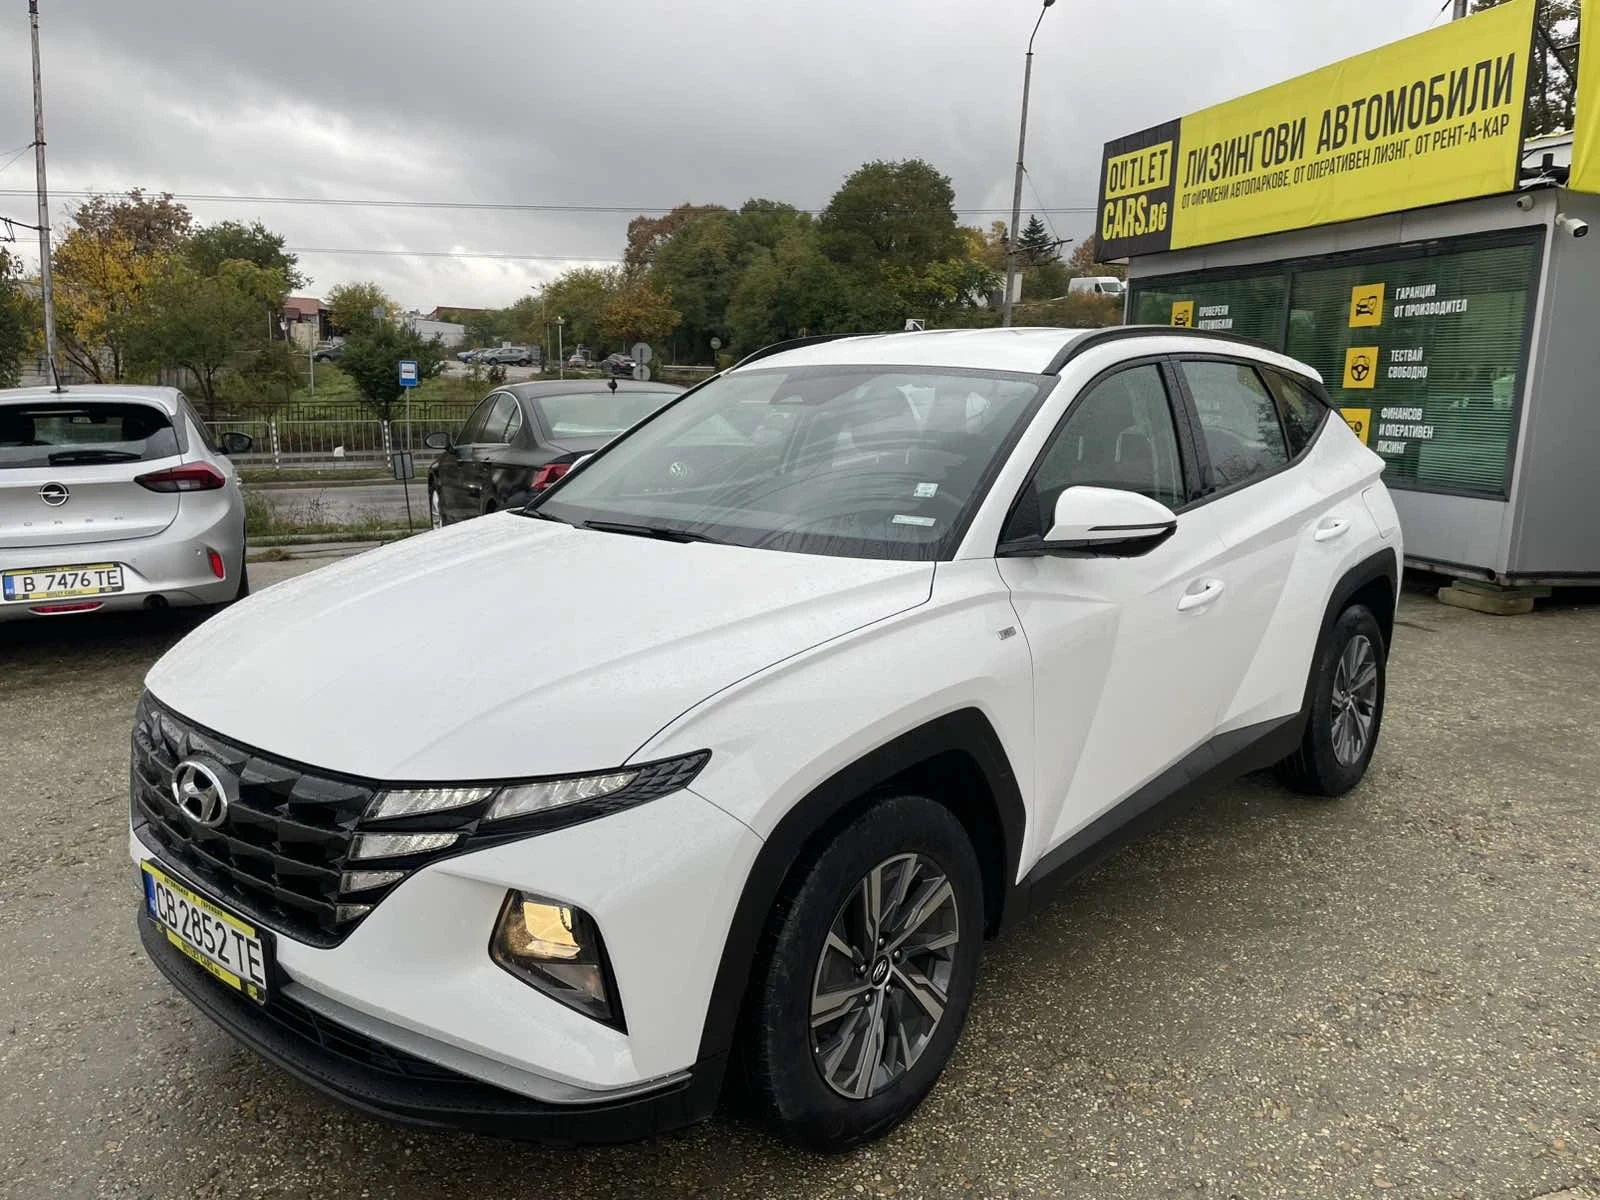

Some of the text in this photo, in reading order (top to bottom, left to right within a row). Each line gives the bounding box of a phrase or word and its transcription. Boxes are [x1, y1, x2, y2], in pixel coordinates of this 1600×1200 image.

[1183, 52, 1516, 189] ЛИЗИНГОВИ АВТОМОБИЛИ
[1293, 165, 1306, 184] ОТ
[1306, 149, 1370, 182] ОПЕРАТИВЕН
[1415, 133, 1431, 155] ОТ
[1432, 113, 1510, 151] РЕНТ-А-КАР
[1109, 149, 1168, 193] OUTLET
[1102, 195, 1168, 241] CARS.BG
[1396, 284, 1436, 300] ГАРАНЦИЯ
[1394, 299, 1468, 318] ОТ ПРОИЗВОДИТЕЛ
[1391, 347, 1423, 362] ТЕСТВАЙ
[1388, 366, 1428, 379] СВОБОДНО
[1381, 408, 1422, 420] ФИНАНСОВ
[1385, 424, 1434, 439] ОПЕРАТИВЕН
[45, 572, 91, 591] 7476
[94, 570, 119, 586] TE
[180, 900, 230, 965] 2852
